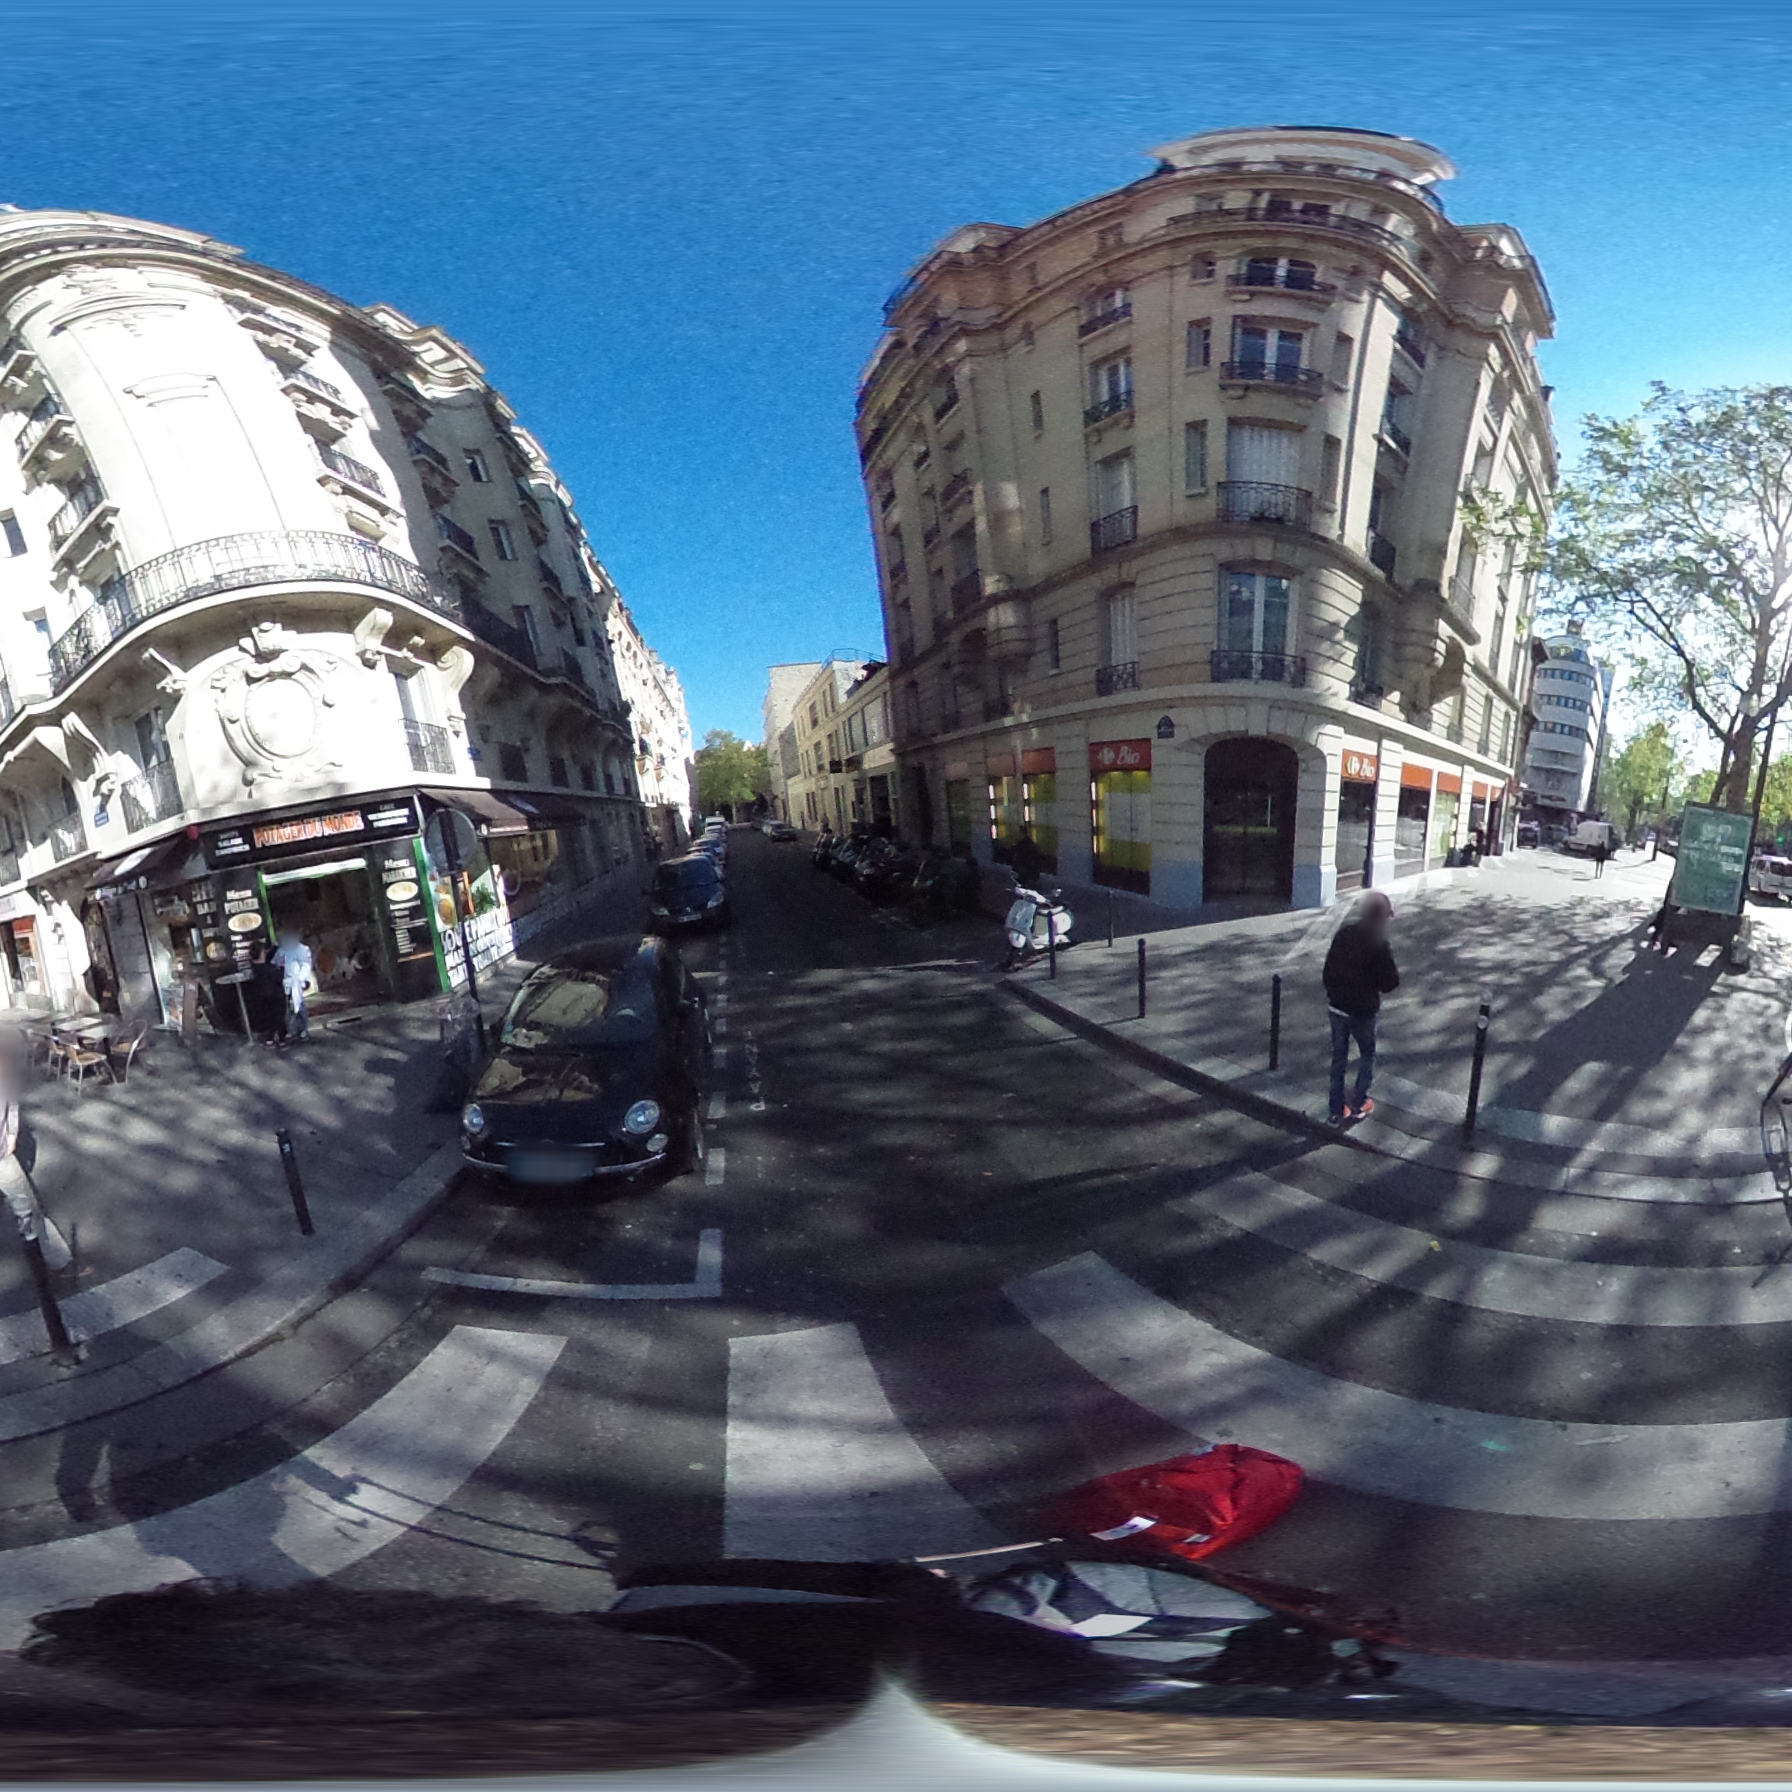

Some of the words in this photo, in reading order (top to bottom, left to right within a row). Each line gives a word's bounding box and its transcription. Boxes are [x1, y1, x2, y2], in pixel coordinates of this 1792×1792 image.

[1117, 746, 1141, 765] Bio
[1360, 758, 1375, 777] Bio
[252, 819, 305, 848] POTAGER
[303, 816, 324, 838] DU
[323, 810, 364, 836] MONDE
